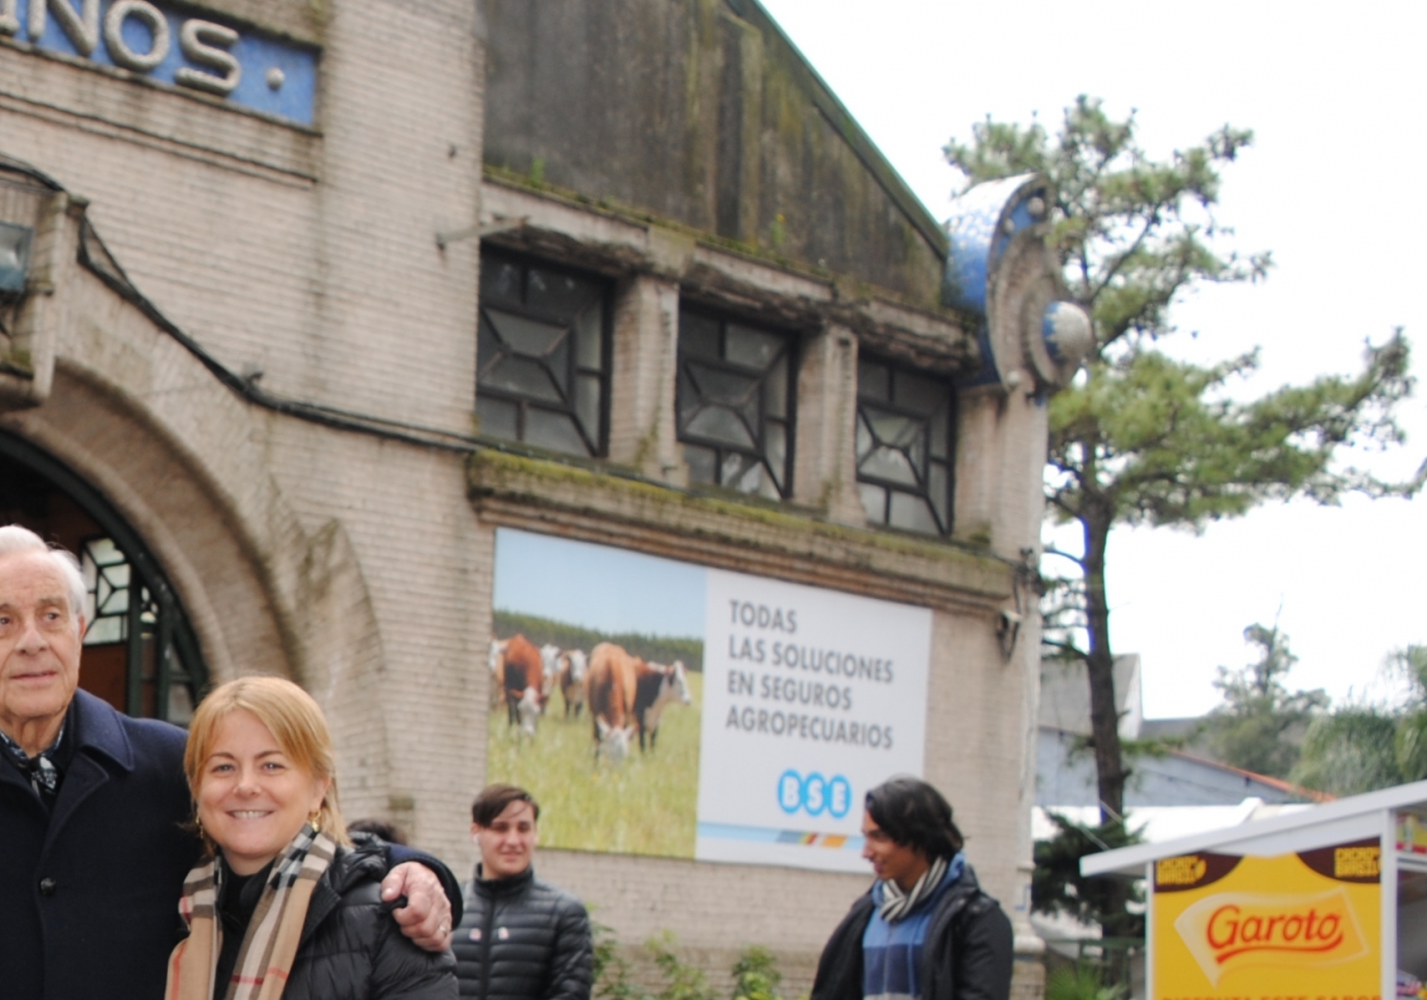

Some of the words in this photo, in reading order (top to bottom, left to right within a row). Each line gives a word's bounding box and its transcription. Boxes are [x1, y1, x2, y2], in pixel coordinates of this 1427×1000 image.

[729, 599, 797, 634] TODAS
[729, 635, 766, 663] LAS
[772, 642, 894, 683] SOLUCIONES
[728, 670, 755, 697] EN
[761, 675, 853, 711] SEGUROS
[726, 705, 894, 750] AGROPECUARIOS
[780, 773, 849, 814] BSE
[1206, 904, 1345, 951] Garoto
